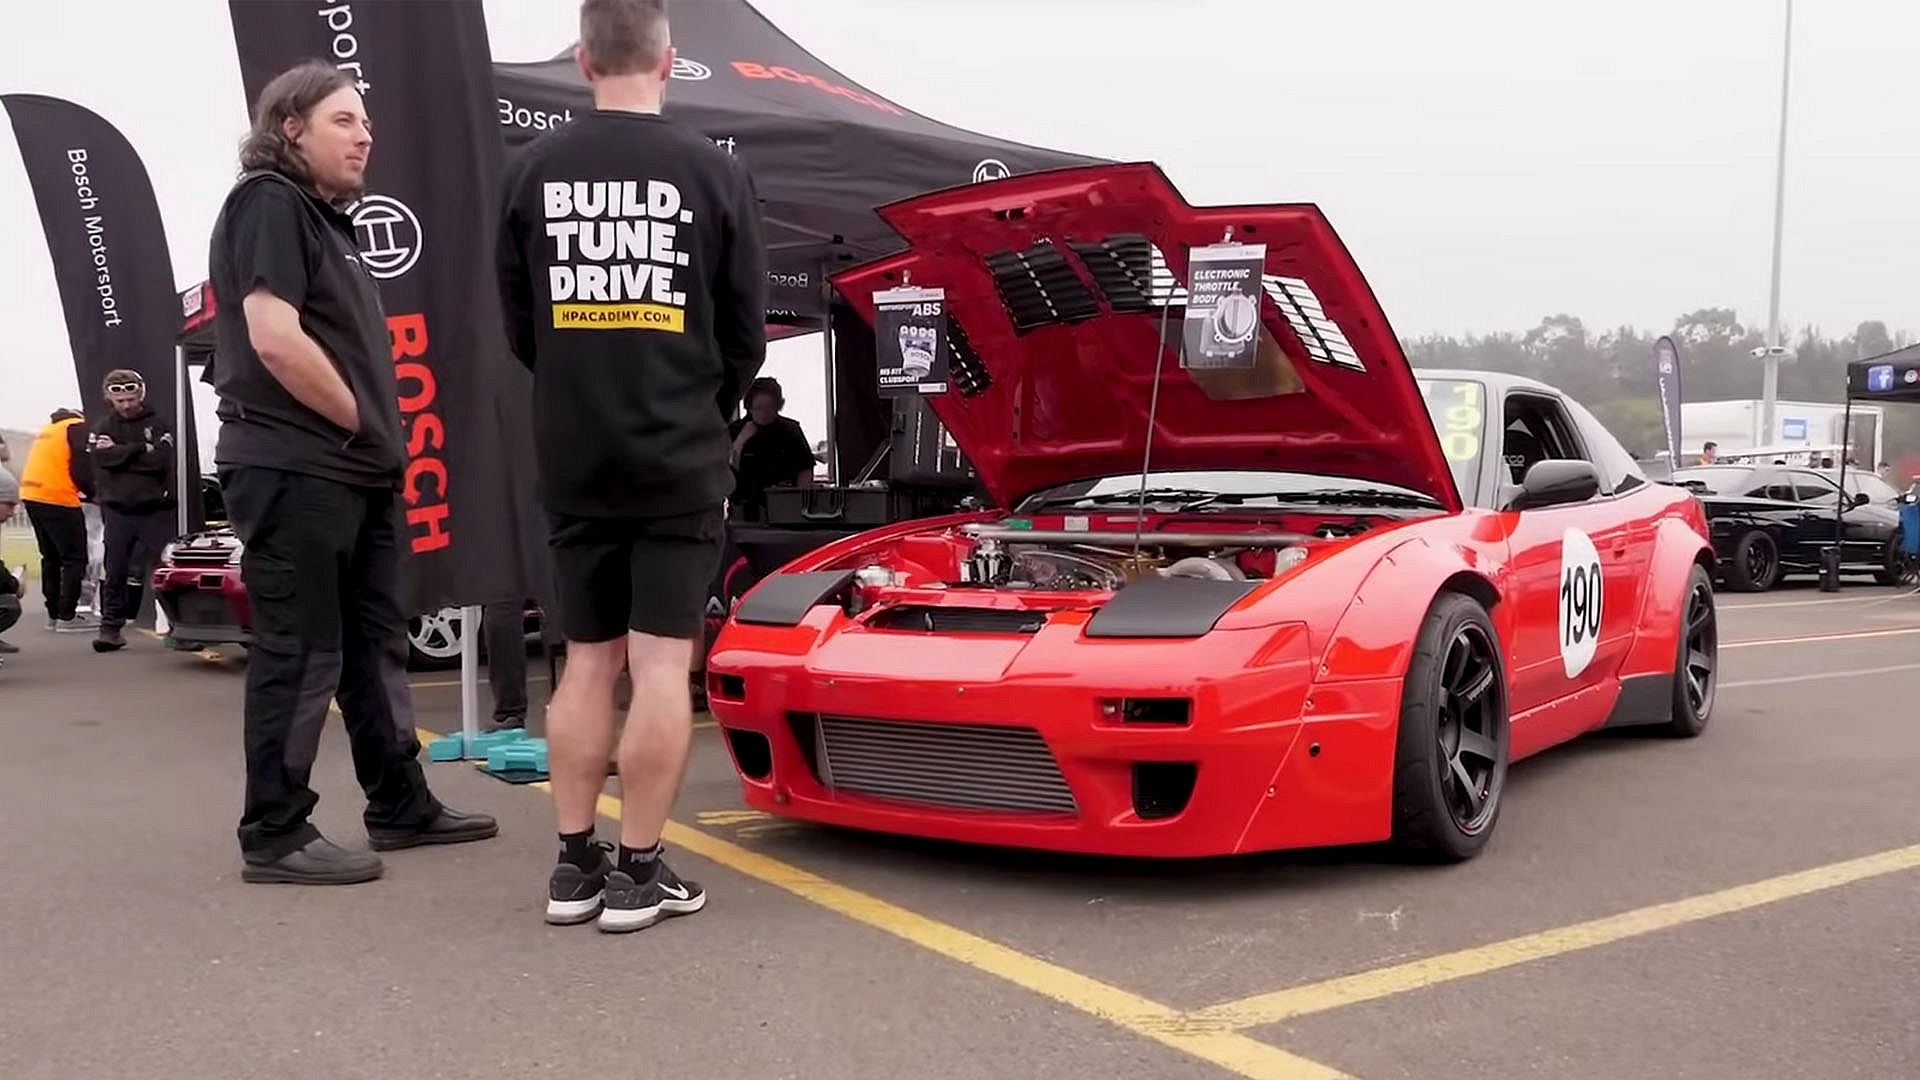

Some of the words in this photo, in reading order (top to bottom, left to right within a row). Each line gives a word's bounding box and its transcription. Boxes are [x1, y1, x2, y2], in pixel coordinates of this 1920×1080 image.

[318, 0, 371, 95] port
[543, 179, 694, 224] BUILD.
[67, 149, 99, 210] Bosch
[84, 215, 123, 328] Motorsport
[546, 219, 690, 267] TUNE.
[549, 263, 687, 306] DRIVE.
[1193, 281, 1240, 292] THROTTLE
[1194, 269, 1250, 280] ELECTRONIC
[562, 311, 671, 323] HPACADEMY.COM
[912, 303, 941, 316] ABS
[1192, 294, 1217, 304] BODY
[385, 313, 450, 553] BOSCH
[1444, 383, 1481, 461] 190
[1561, 562, 1602, 647] 190
